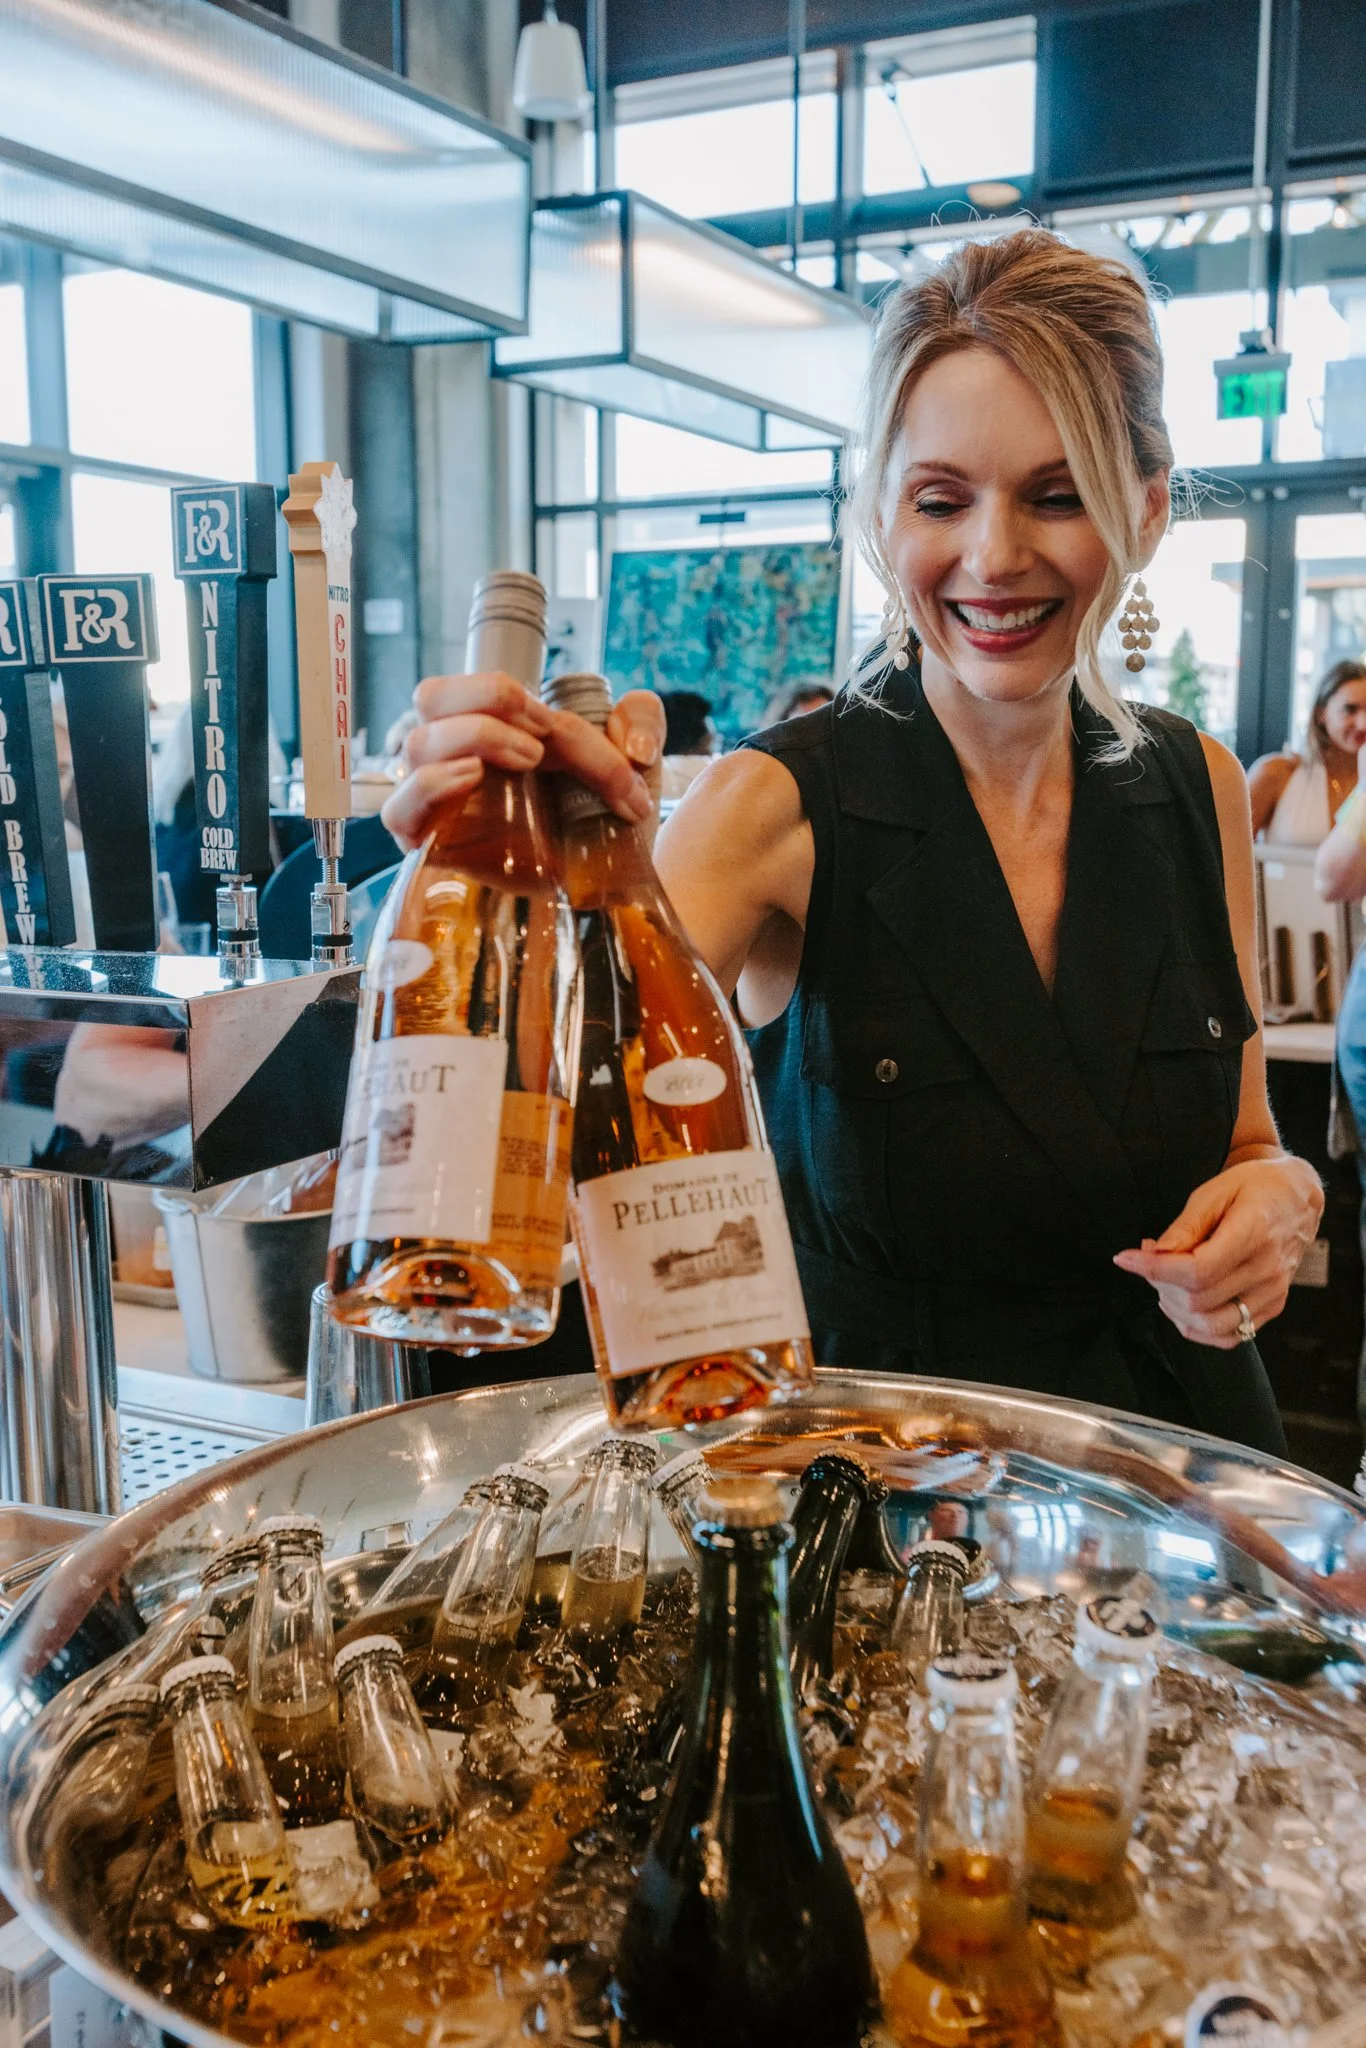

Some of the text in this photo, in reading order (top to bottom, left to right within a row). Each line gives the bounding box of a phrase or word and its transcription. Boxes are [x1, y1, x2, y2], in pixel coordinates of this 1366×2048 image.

[183, 499, 233, 563] F&R
[59, 588, 136, 651] F&R
[328, 584, 350, 603] NITRO
[200, 581, 227, 819] NITRO
[334, 613, 348, 783] CHAI
[200, 848, 238, 871] BREW
[202, 826, 234, 849] COLD
[4, 819, 36, 944] BREW
[611, 1179, 770, 1231] PELLEHAUT
